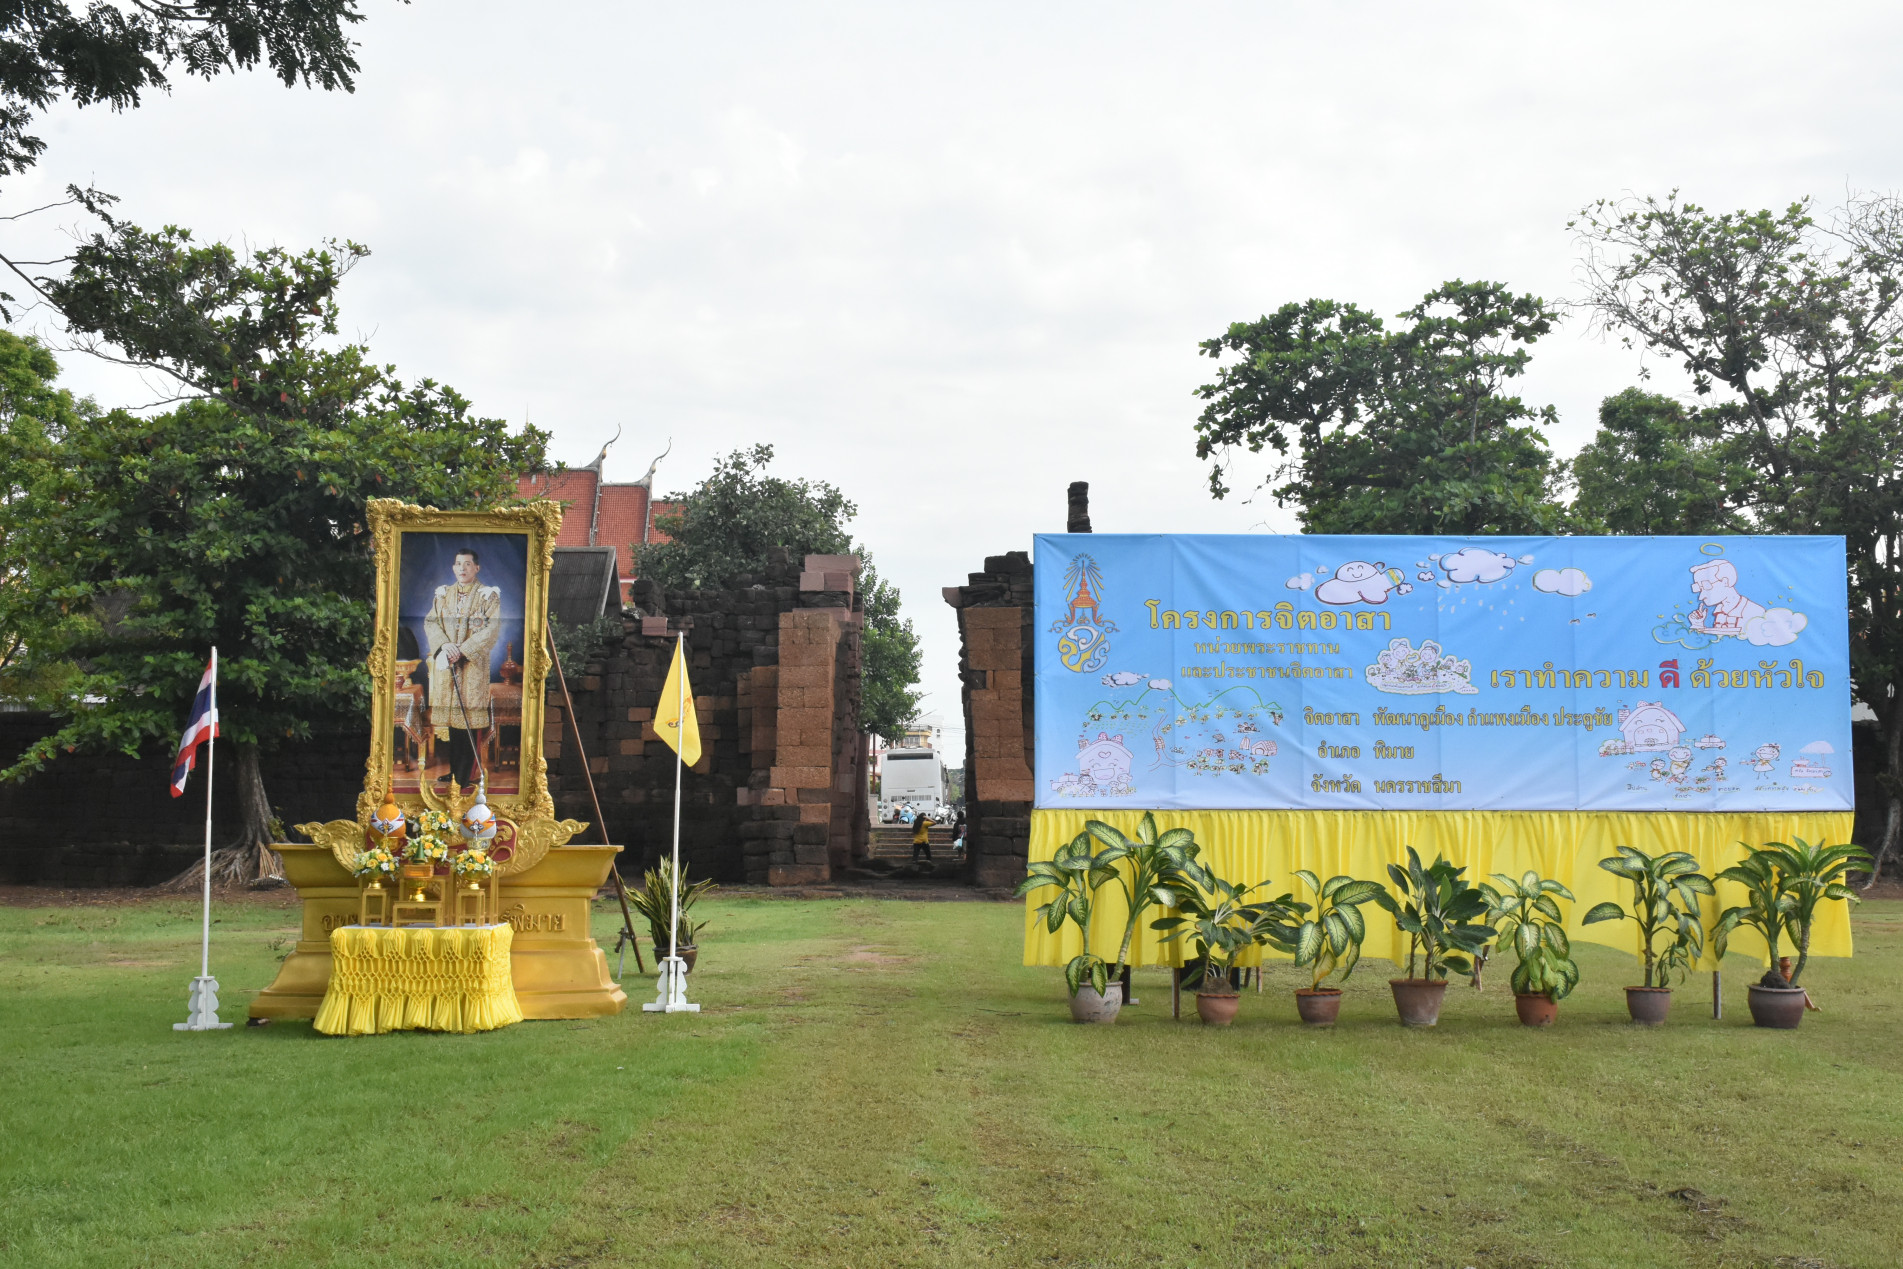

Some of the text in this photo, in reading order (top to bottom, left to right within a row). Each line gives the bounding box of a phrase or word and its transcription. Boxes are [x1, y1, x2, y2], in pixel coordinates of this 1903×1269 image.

[1144, 599, 1391, 630] โครงการจิตอาสา
[1194, 636, 1340, 655] หน่วยพระราชทาน
[1181, 661, 1353, 679] และประชาชนจิตอาสา
[1490, 658, 1825, 689] เราทำความ ดี ด้วยหัวใจ
[1303, 705, 1613, 731] จิตอาสา พัฒนาคูเมือง กำแพงเมือง ประตูชัย
[1318, 740, 1415, 759] อำเภอ พิมาย
[1311, 773, 1462, 793] จังหวัด นครราชสีมา
